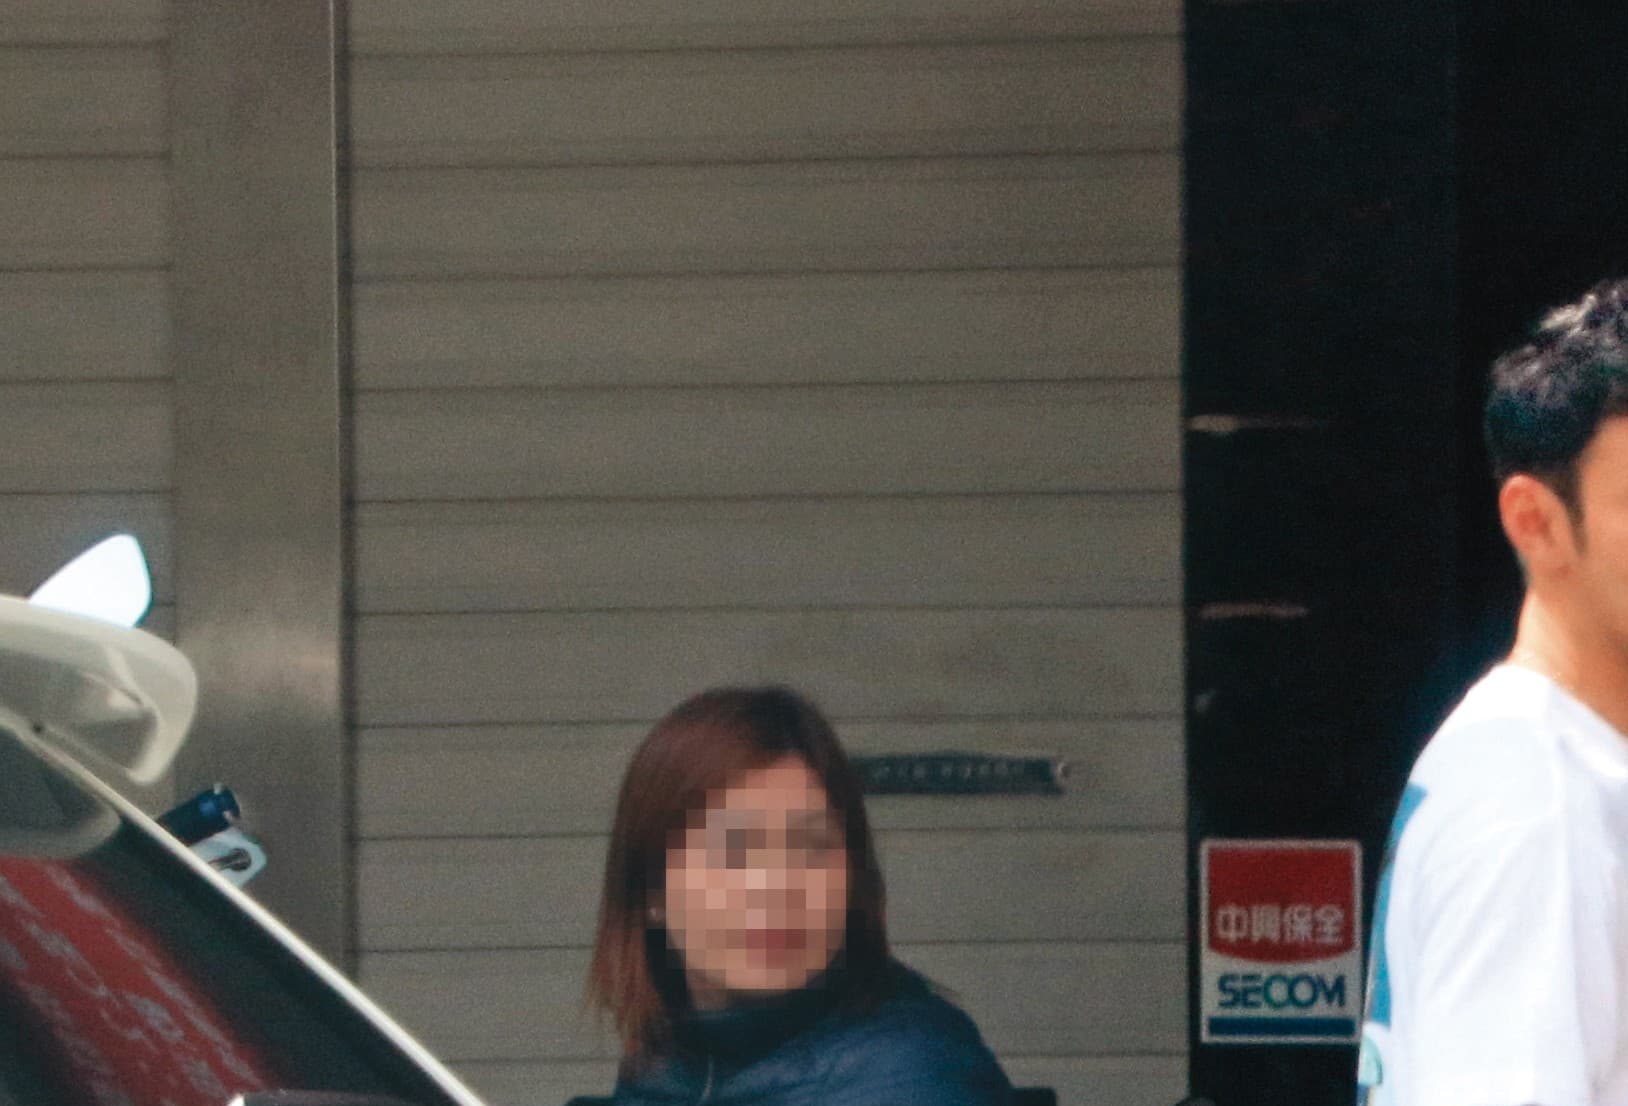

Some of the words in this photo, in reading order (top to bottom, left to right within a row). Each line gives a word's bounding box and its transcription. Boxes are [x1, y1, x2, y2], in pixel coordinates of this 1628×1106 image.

[1216, 903, 1346, 944] 中興保全
[1216, 971, 1347, 1010] SECOM
